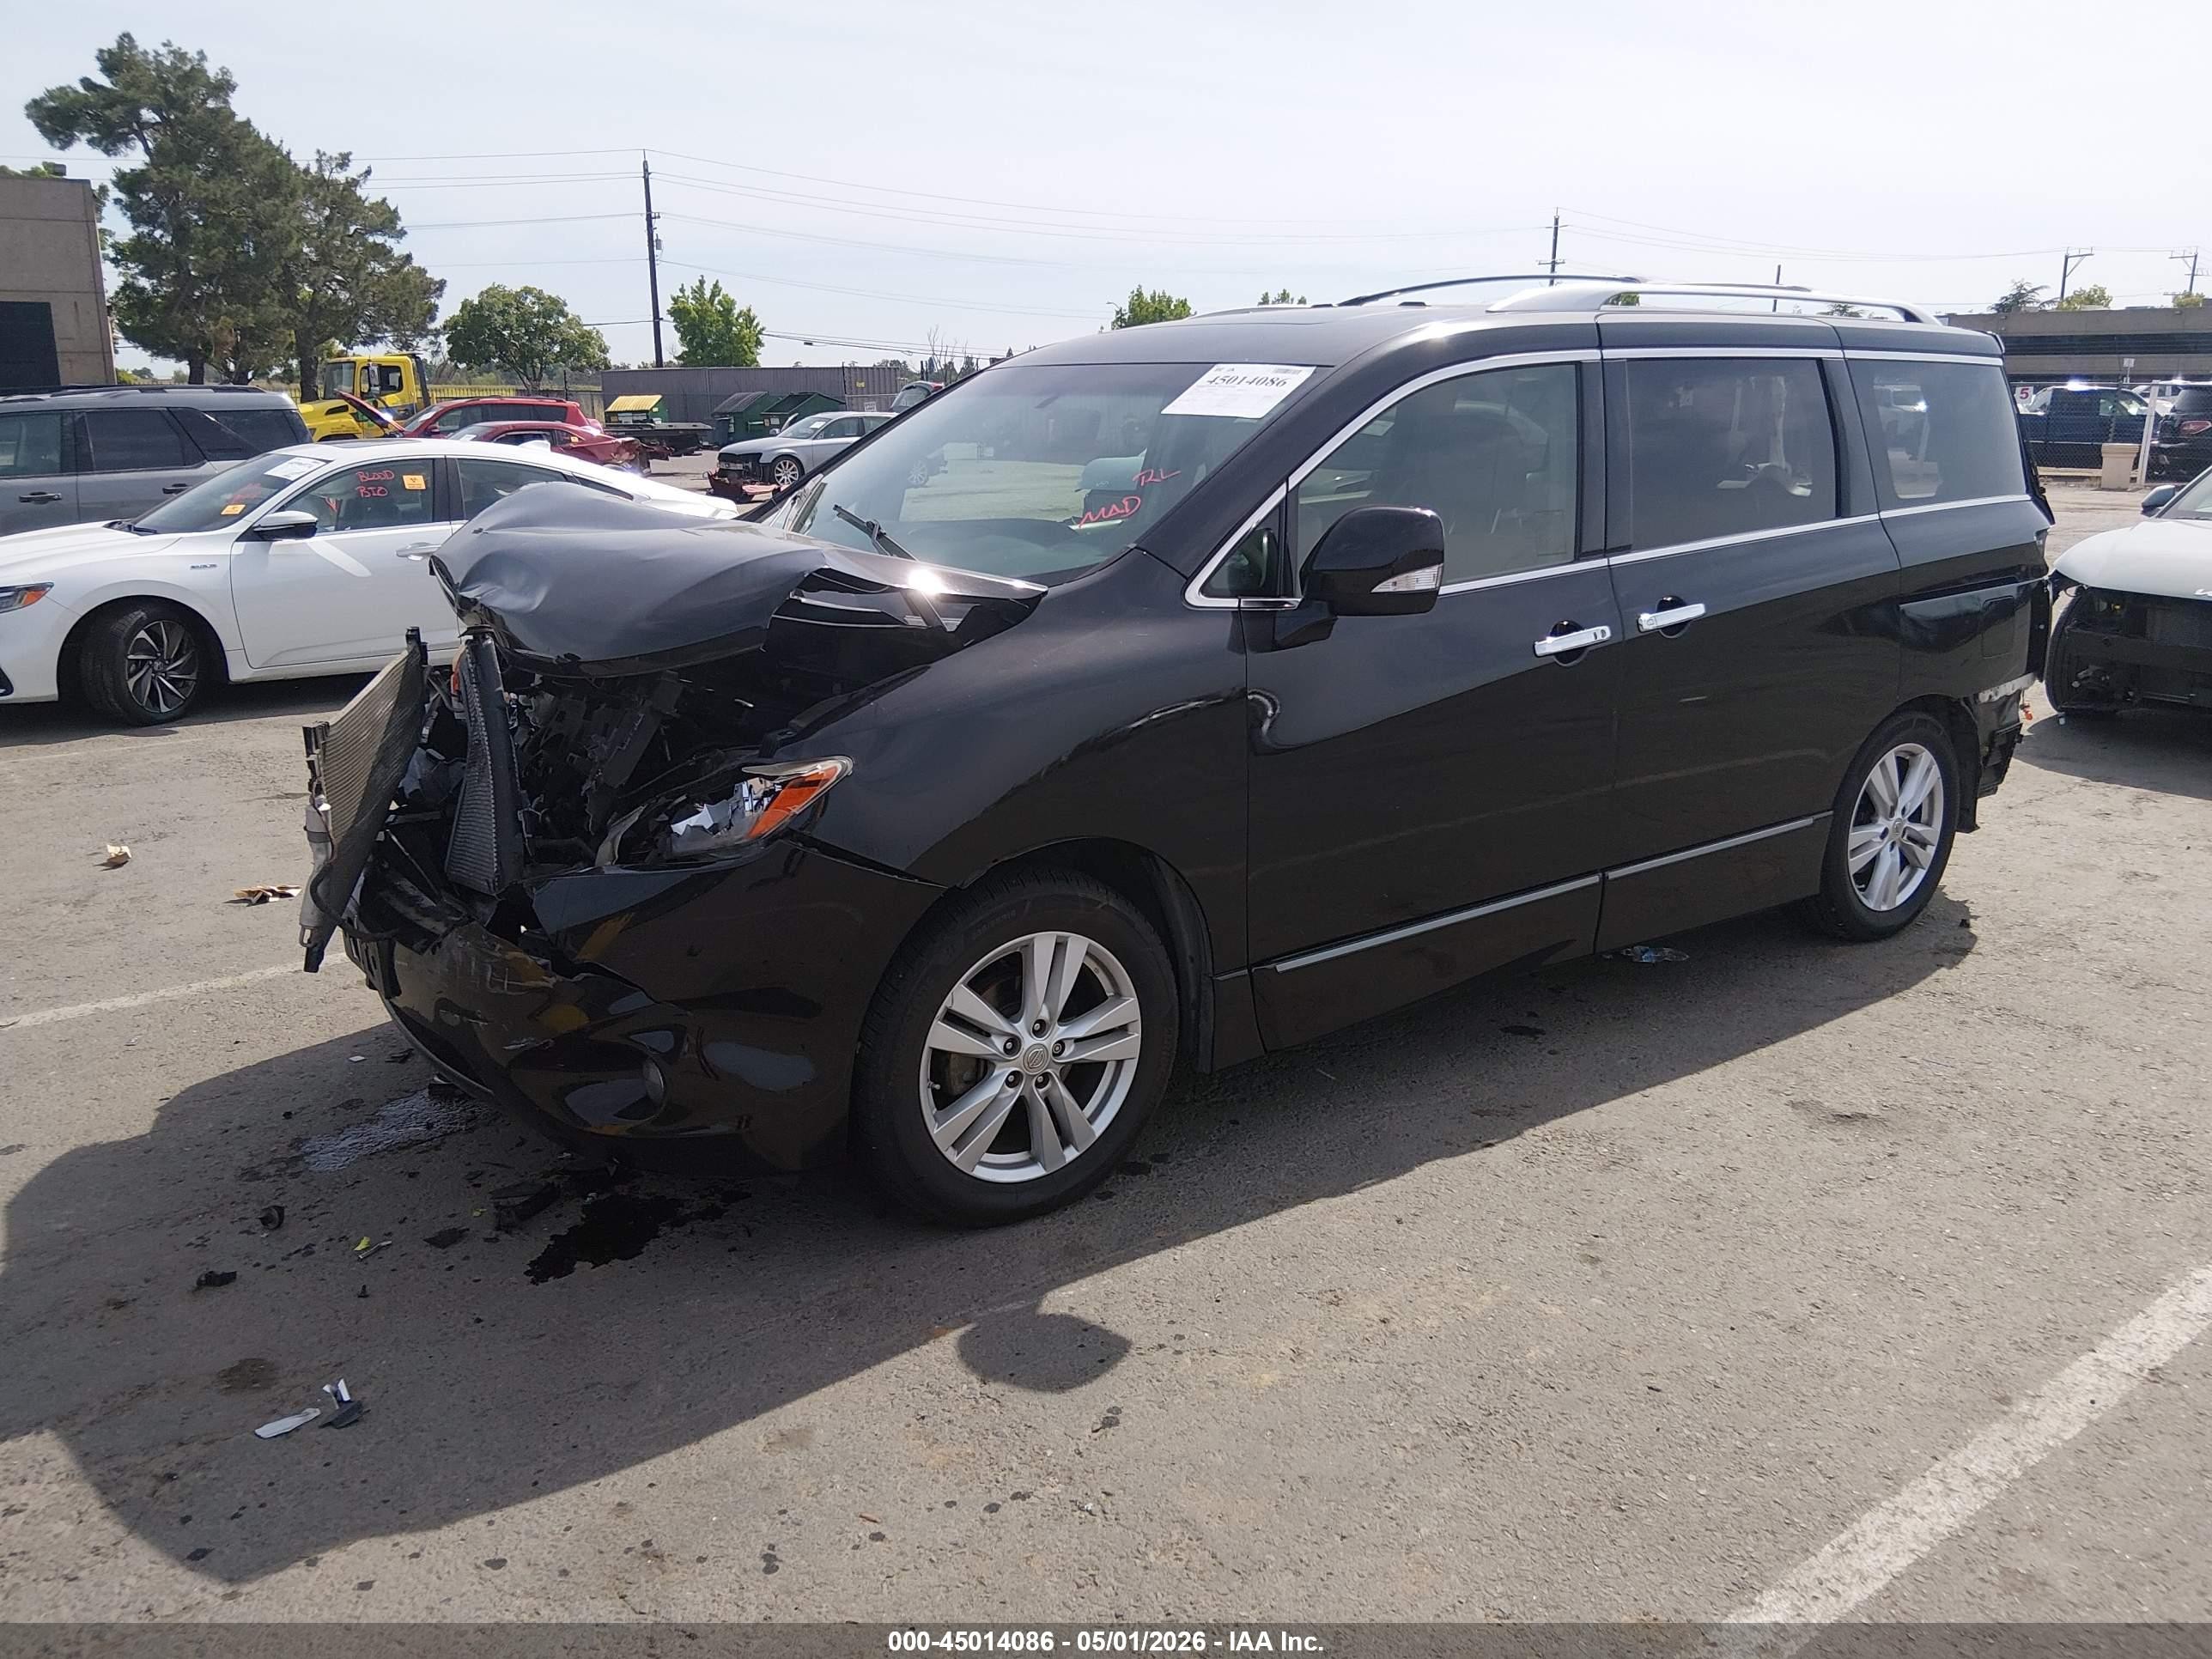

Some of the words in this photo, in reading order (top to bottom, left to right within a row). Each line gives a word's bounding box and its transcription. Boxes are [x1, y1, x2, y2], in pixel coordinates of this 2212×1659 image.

[1206, 375, 1289, 387] 45014086
[2020, 388, 2030, 400] 5
[356, 470, 395, 482] BLOOD
